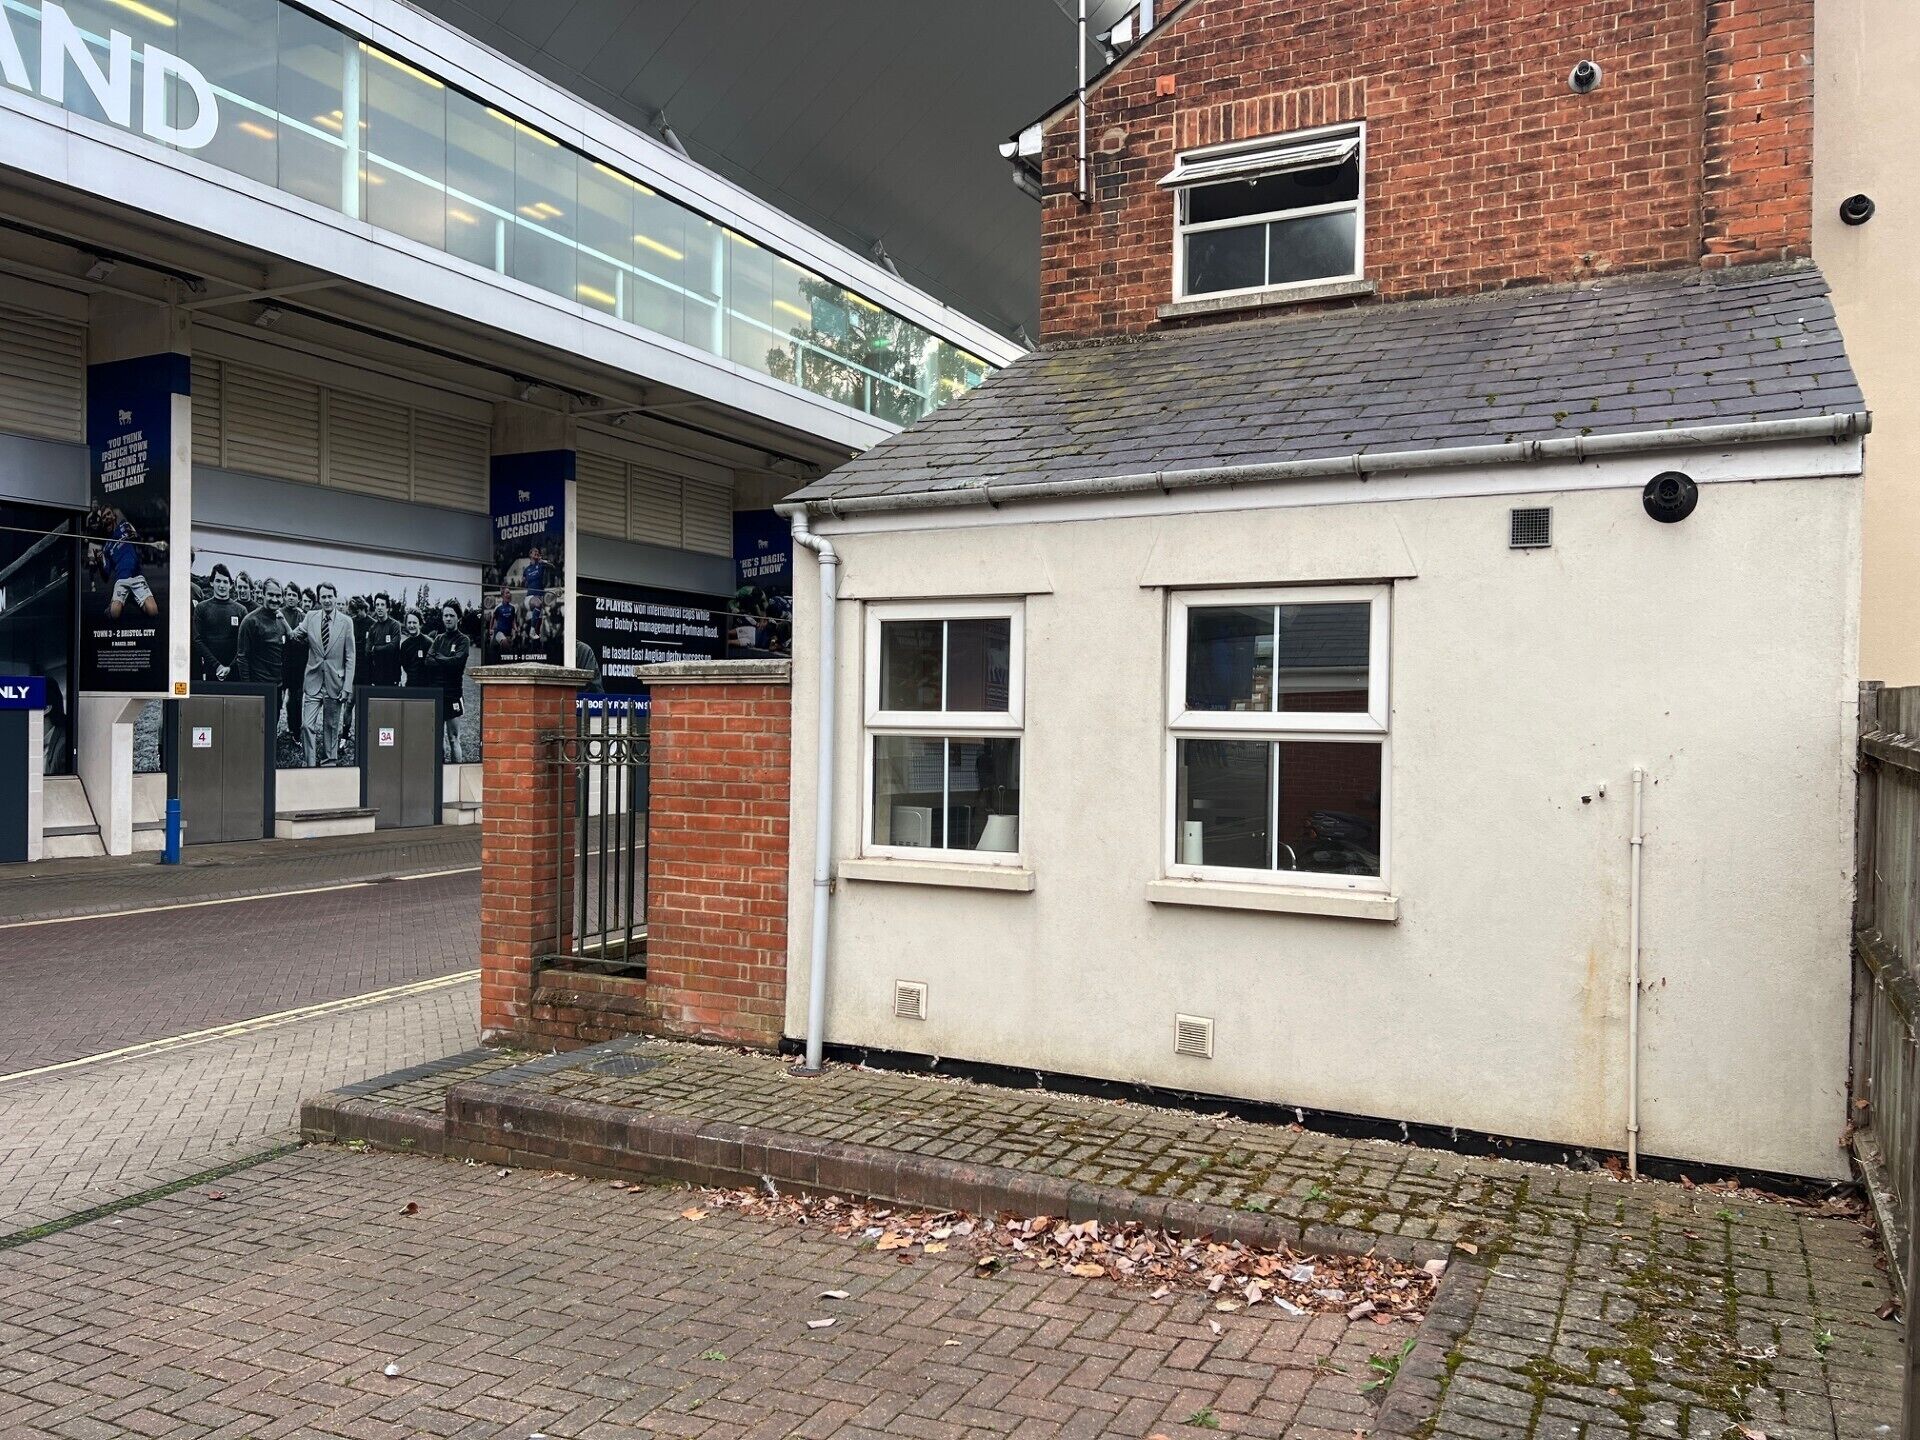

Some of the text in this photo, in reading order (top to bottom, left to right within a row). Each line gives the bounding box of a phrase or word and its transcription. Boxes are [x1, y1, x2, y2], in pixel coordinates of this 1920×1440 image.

[122, 431, 142, 445] THINK
[102, 440, 148, 462] IPSWICH TOWN
[104, 451, 147, 471] ARE GOING TO
[101, 468, 125, 483] WITHER
[104, 480, 124, 492] THINK
[511, 505, 554, 525] HISTORIC
[743, 568, 758, 578] YOU
[596, 598, 710, 621] 22 PLAYERS won international caps while
[596, 616, 719, 638] under Bobby's management at Portman Road.
[602, 646, 610, 658] He
[612, 646, 630, 660] tasted
[631, 647, 643, 660] East
[645, 648, 665, 663] Anglian
[198, 732, 206, 742] 4
[381, 732, 392, 741] 3A
